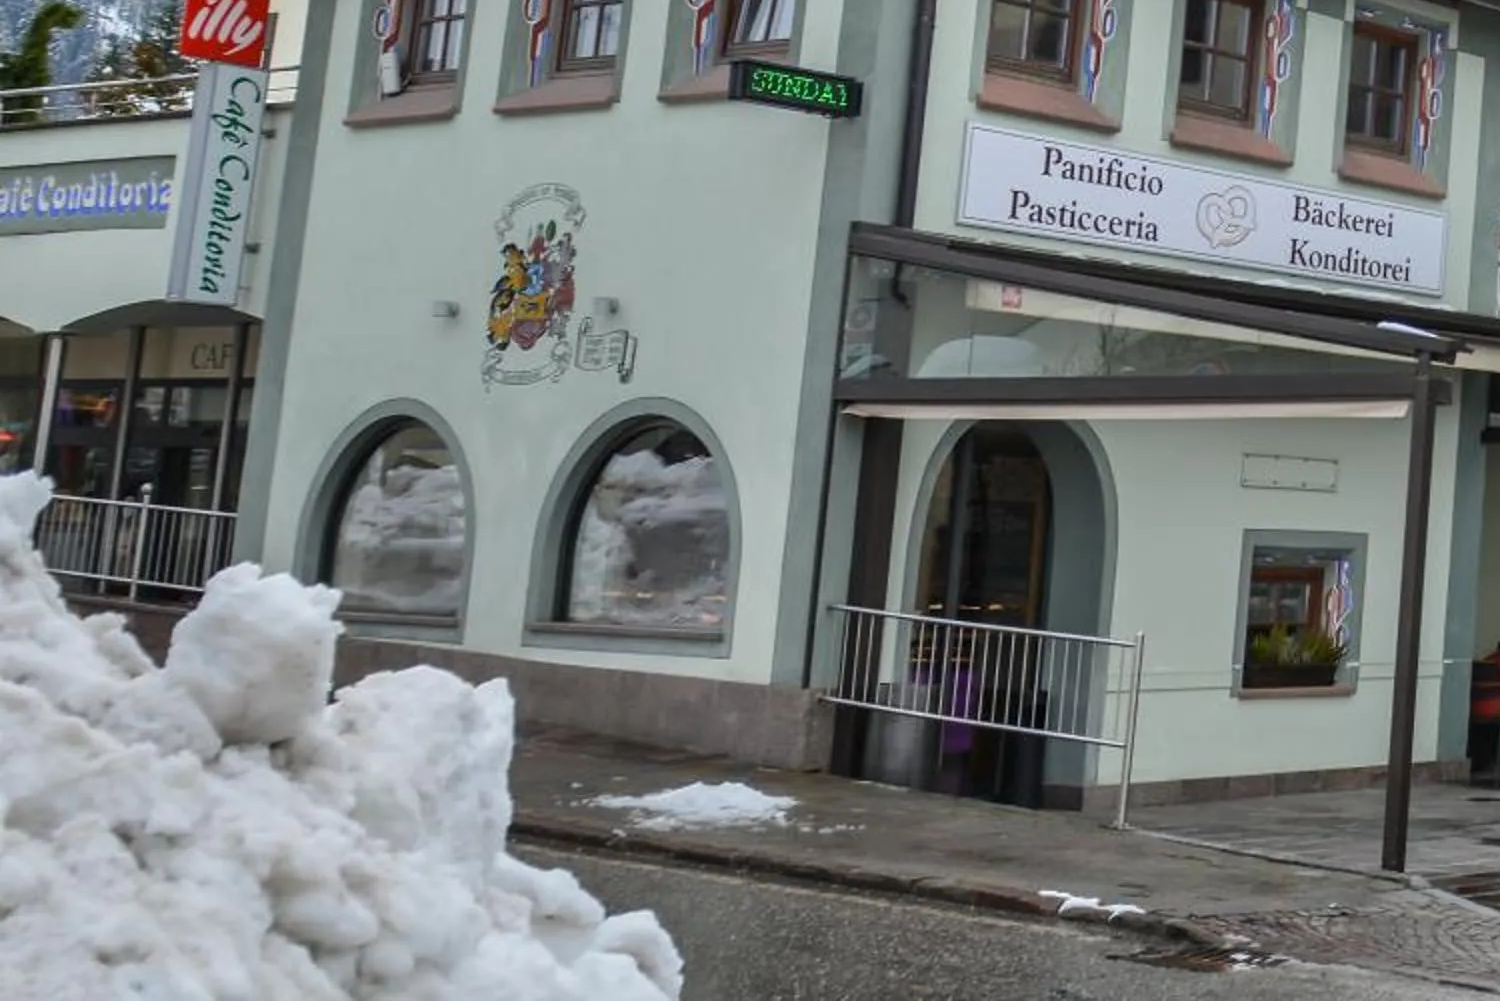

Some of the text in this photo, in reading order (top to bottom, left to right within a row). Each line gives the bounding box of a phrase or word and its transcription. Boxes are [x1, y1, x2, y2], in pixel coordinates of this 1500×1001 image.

[1041, 145, 1164, 197] Panificio
[199, 154, 250, 293] Conditoria
[1008, 189, 1159, 243] Pasticceria
[1291, 195, 1394, 239] Bäckerei
[1288, 237, 1412, 283] Konditorei
[190, 342, 235, 370] CAF
